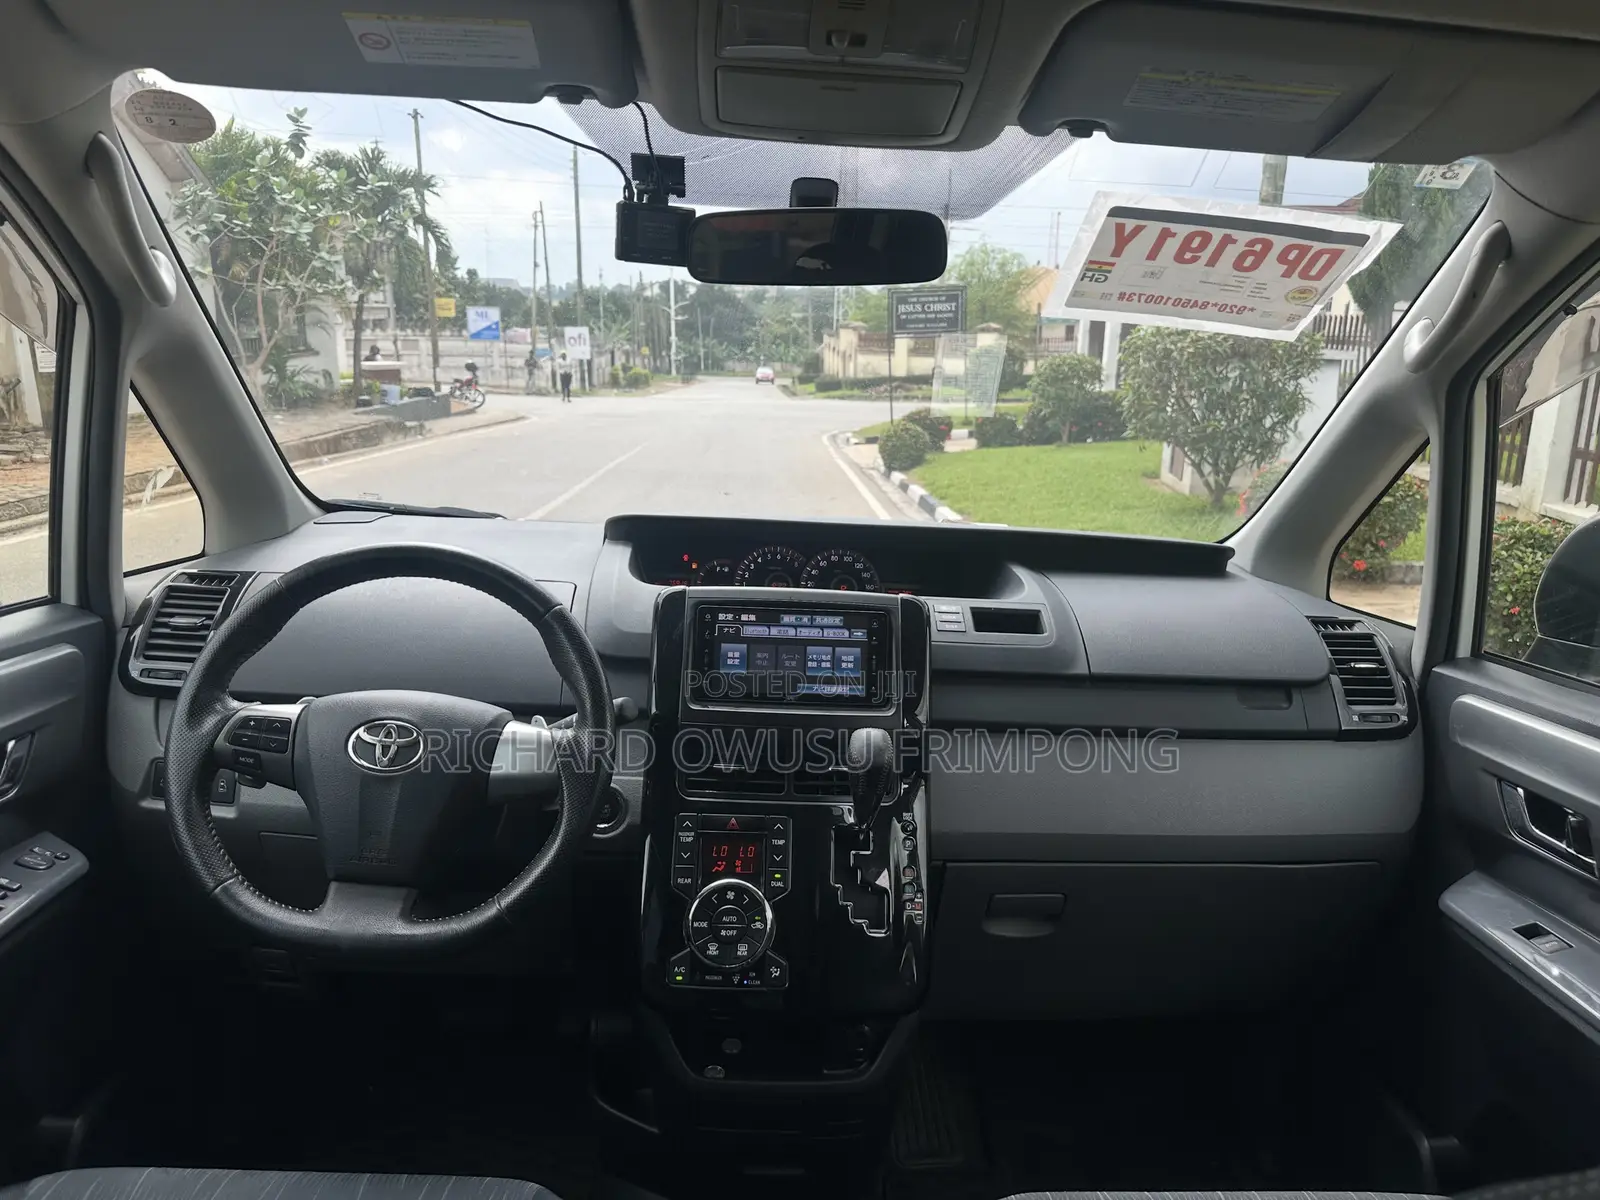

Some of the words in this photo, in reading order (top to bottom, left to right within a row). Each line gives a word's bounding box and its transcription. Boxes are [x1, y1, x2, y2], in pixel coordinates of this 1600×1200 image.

[897, 303, 922, 315] JESUS
[924, 302, 956, 312] CHRIST
[568, 332, 587, 347] ofi
